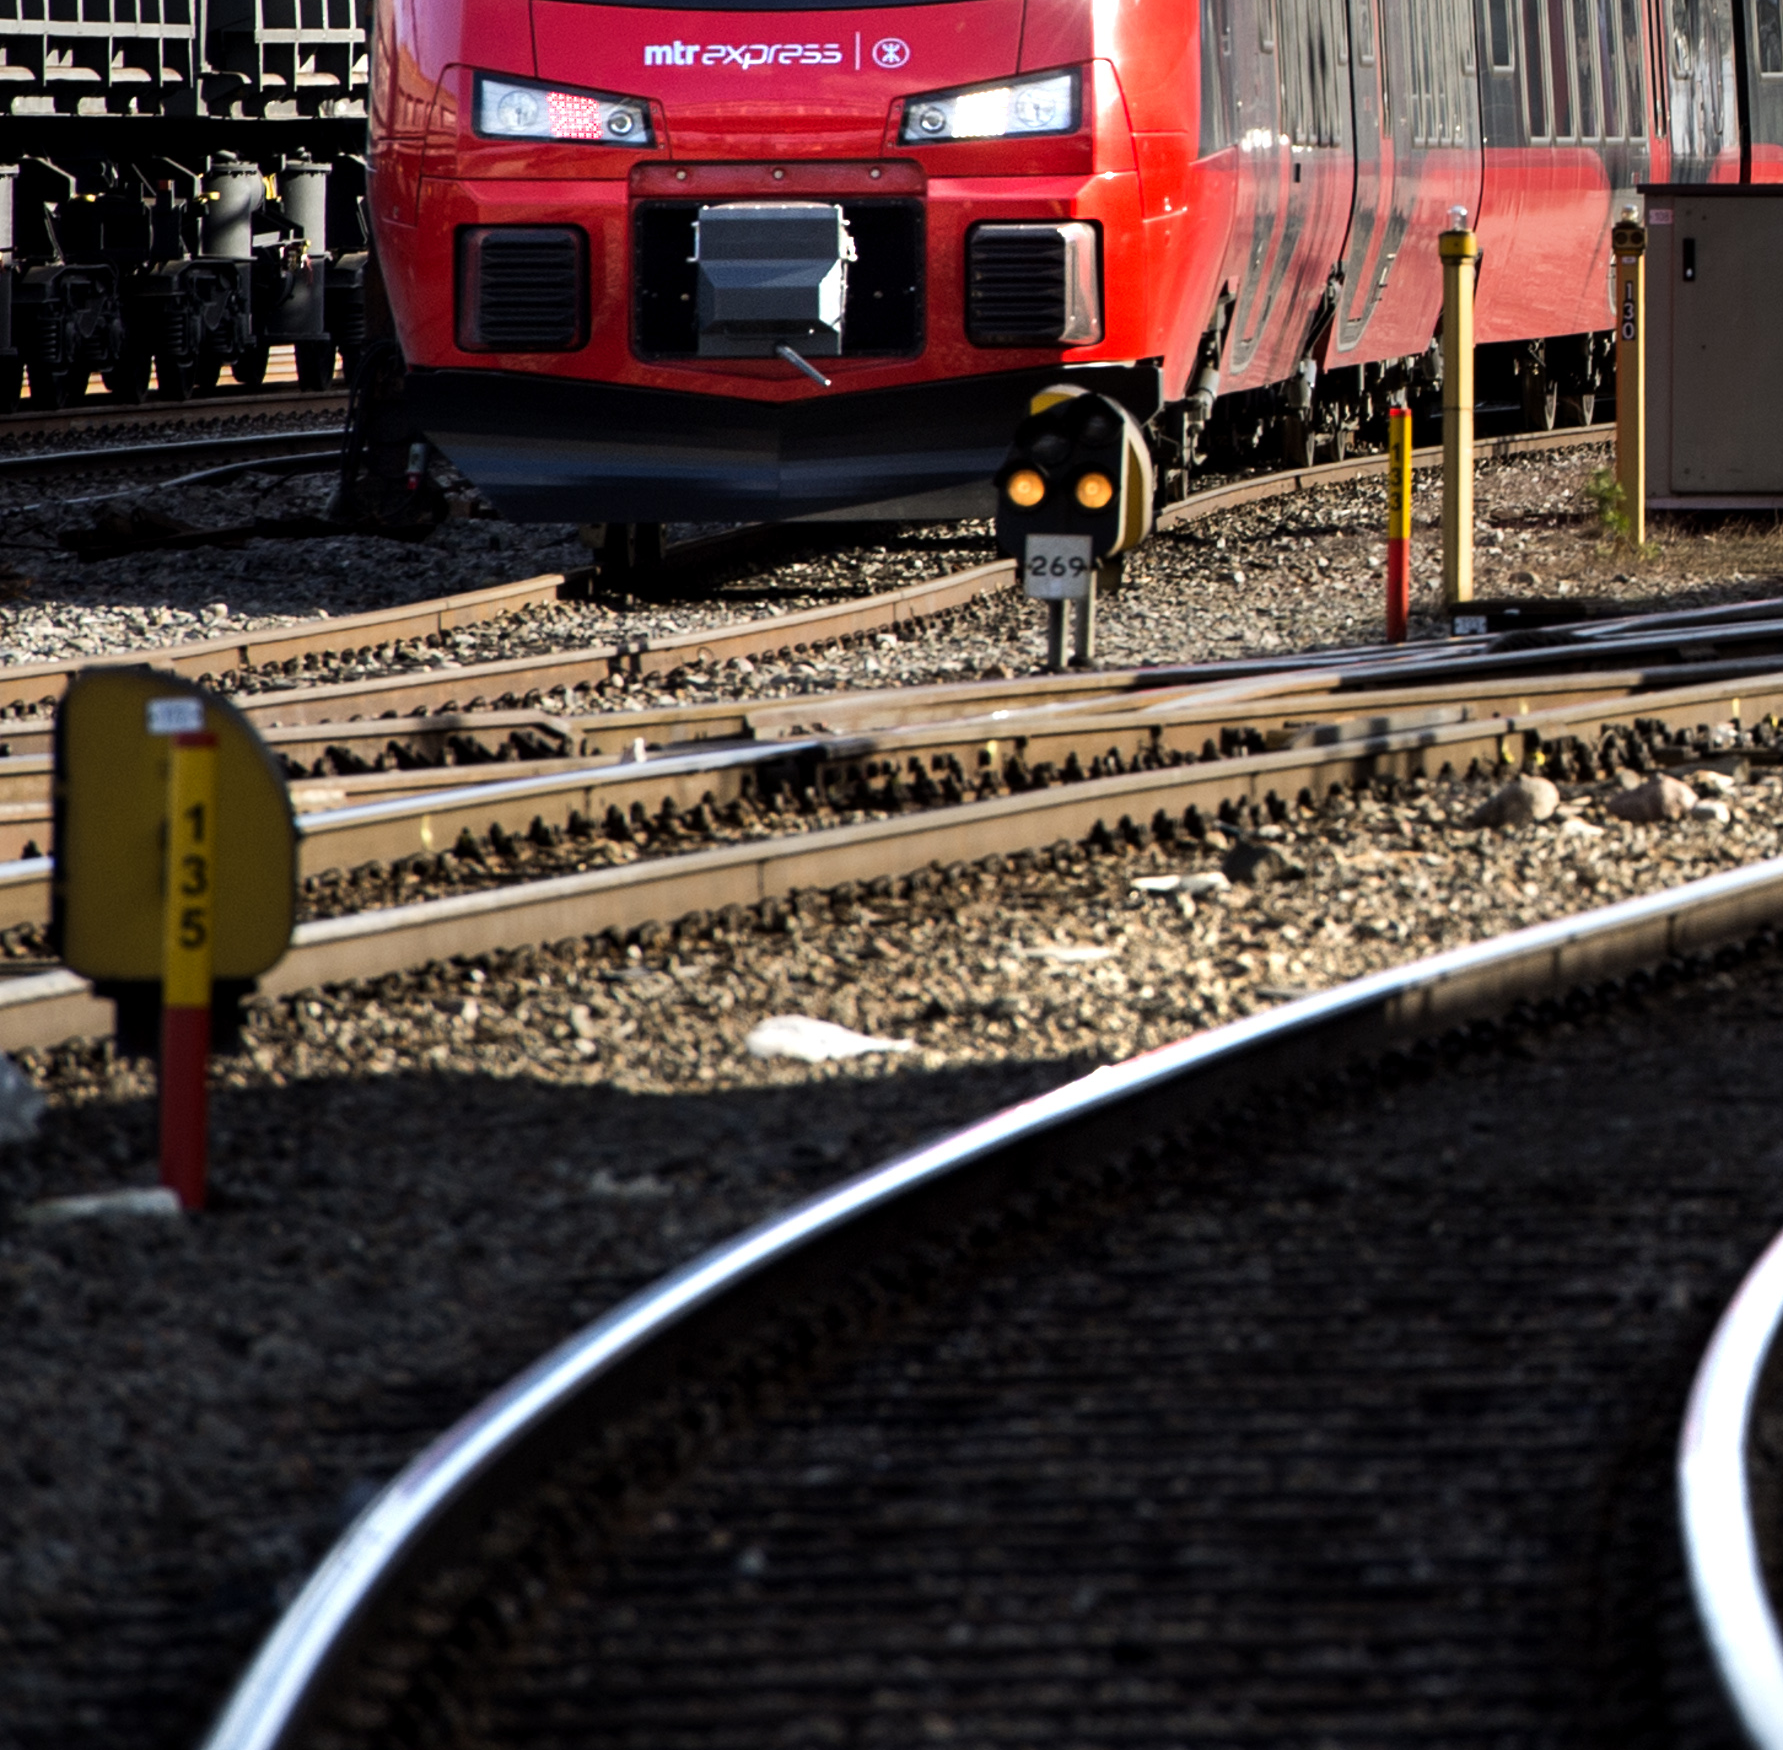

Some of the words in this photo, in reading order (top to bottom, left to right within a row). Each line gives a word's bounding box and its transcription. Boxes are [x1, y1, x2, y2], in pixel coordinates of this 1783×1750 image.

[643, 40, 700, 66] mtr
[701, 44, 842, 70] express
[1622, 281, 1636, 341] 130
[1390, 442, 1403, 512] 133
[1031, 555, 1084, 578] 269
[179, 802, 211, 948] 135
